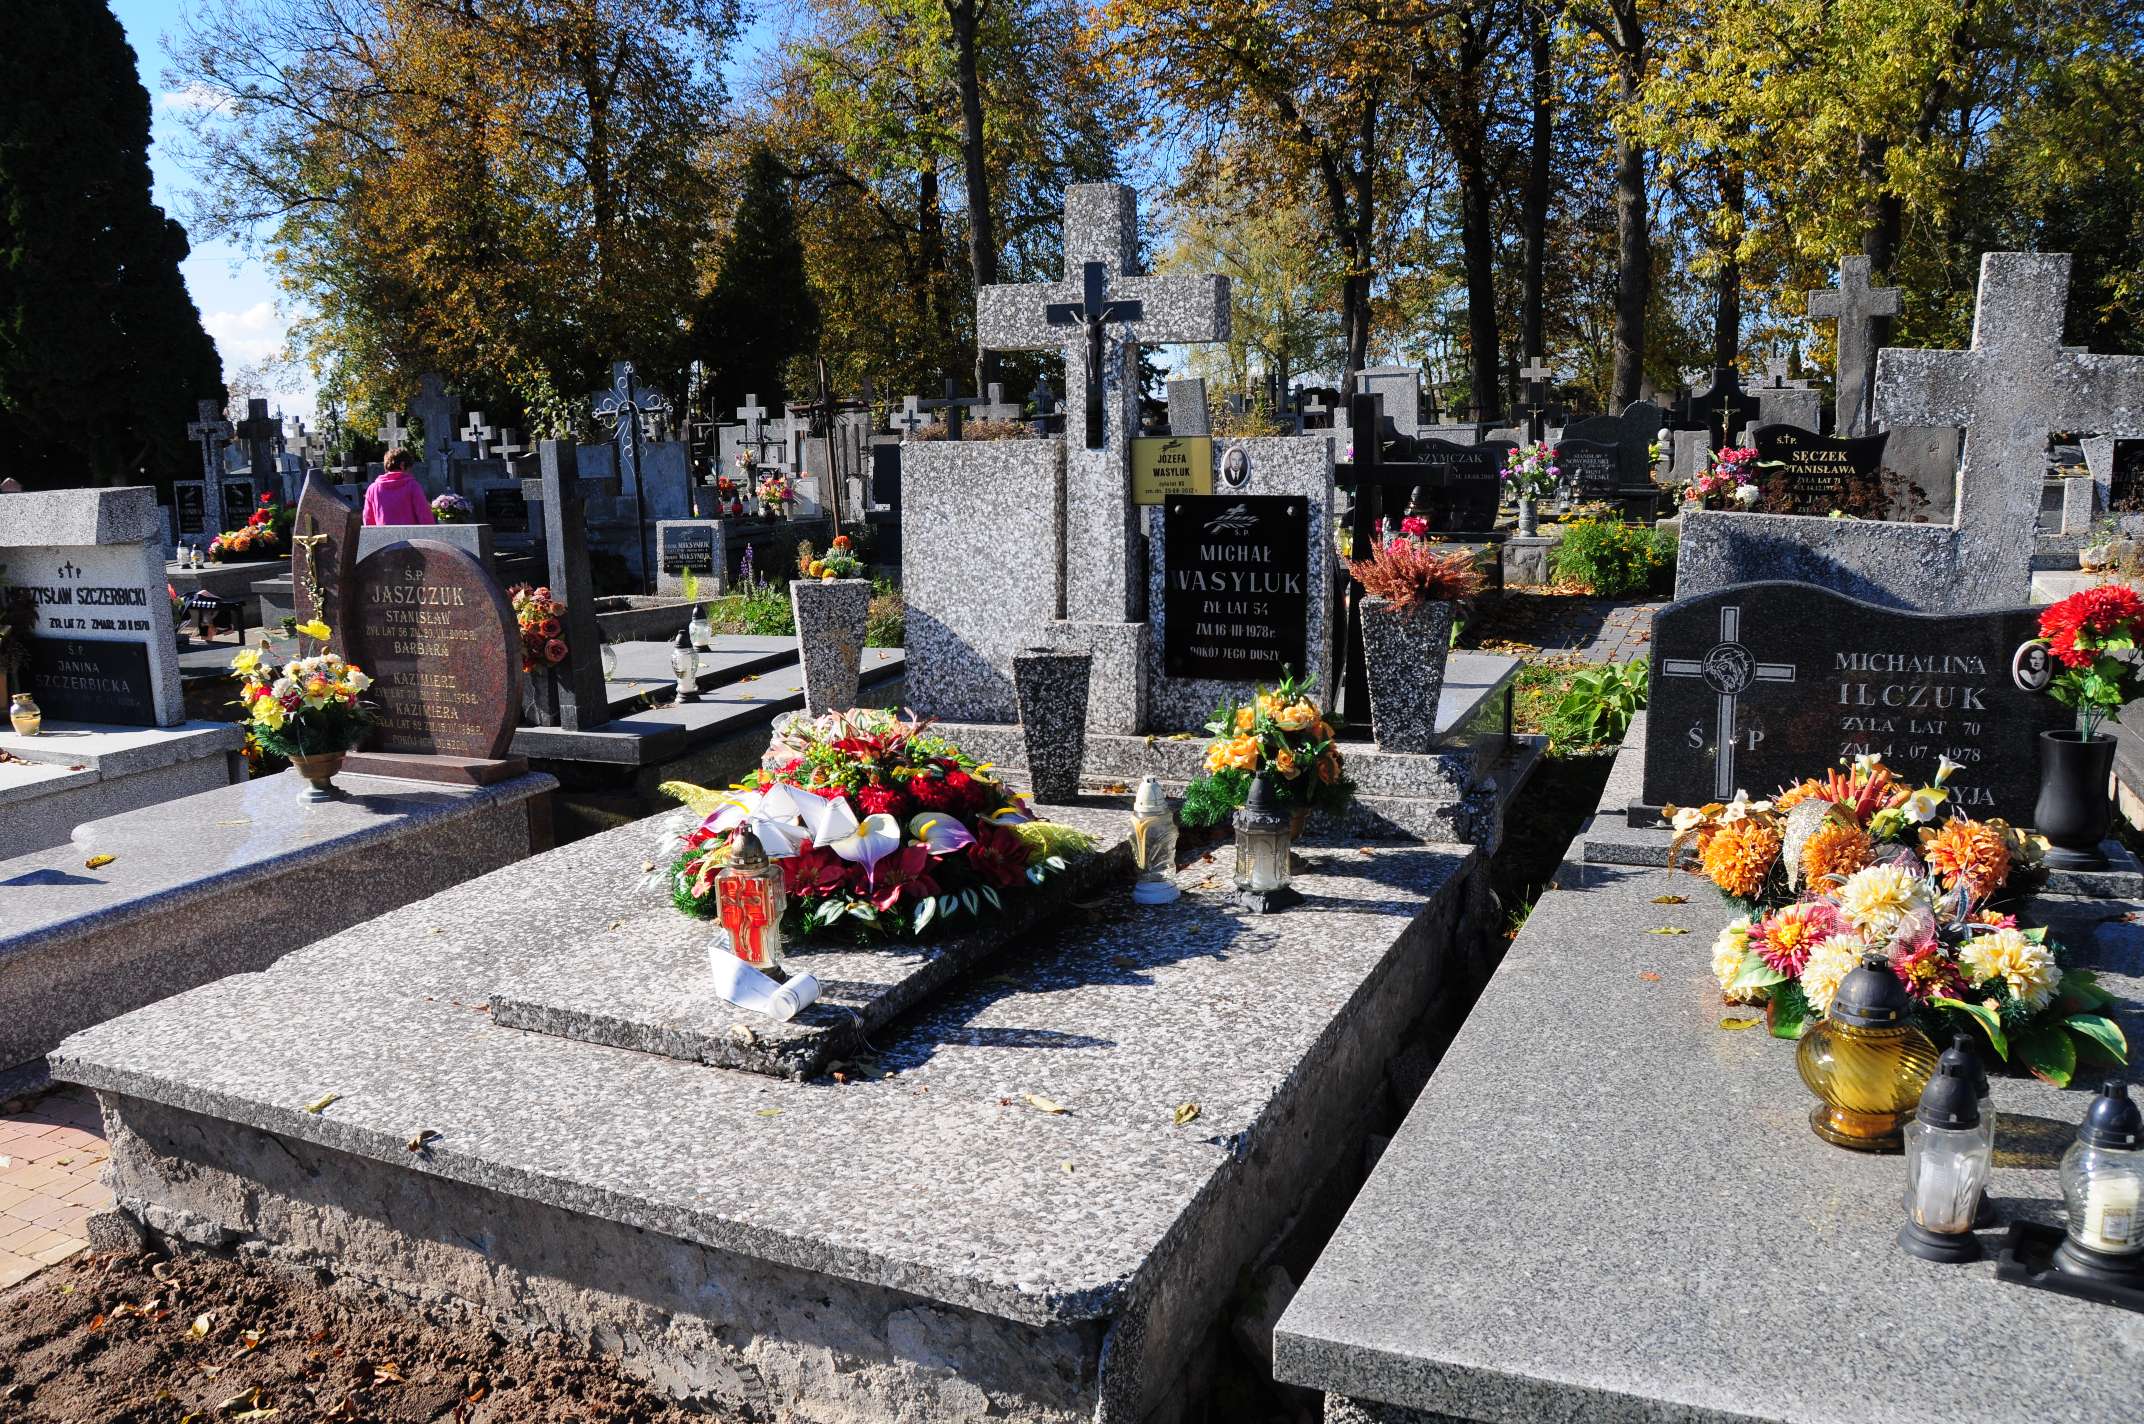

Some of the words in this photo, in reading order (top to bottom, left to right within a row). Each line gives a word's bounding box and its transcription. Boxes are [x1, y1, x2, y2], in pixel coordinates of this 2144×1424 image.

[1157, 452, 1187, 463] JÓZEFA
[1418, 453, 1482, 464] SZYMCZAK
[1792, 450, 1848, 463] SĘCZEK
[1153, 467, 1190, 477] WASYLUK
[1200, 544, 1271, 562] MICHAŁ
[1170, 569, 1301, 594] WASYLUK
[76, 587, 147, 606] SZCZERBICKI
[372, 585, 464, 606] JASZCZUK
[1203, 600, 1221, 614] ŻYŁ
[1227, 601, 1247, 615] LAT
[1253, 603, 1269, 616] 54
[76, 618, 87, 629] 72
[386, 610, 451, 625] STANISŁAW
[394, 641, 449, 656] BARBARA
[1222, 647, 1246, 660] JEGO
[1250, 648, 1280, 661] DUSZY
[58, 659, 100, 673] JANINA
[1834, 652, 1987, 675] MICHALINA
[35, 674, 131, 693] SZCZERBICKA
[1837, 683, 1987, 710] ILCZUK
[1841, 716, 1895, 732] ŻYŁA
[1908, 719, 1947, 735] LAT
[1962, 722, 1981, 736] 70
[1688, 720, 1704, 749] Ś
[1744, 729, 1765, 751] P
